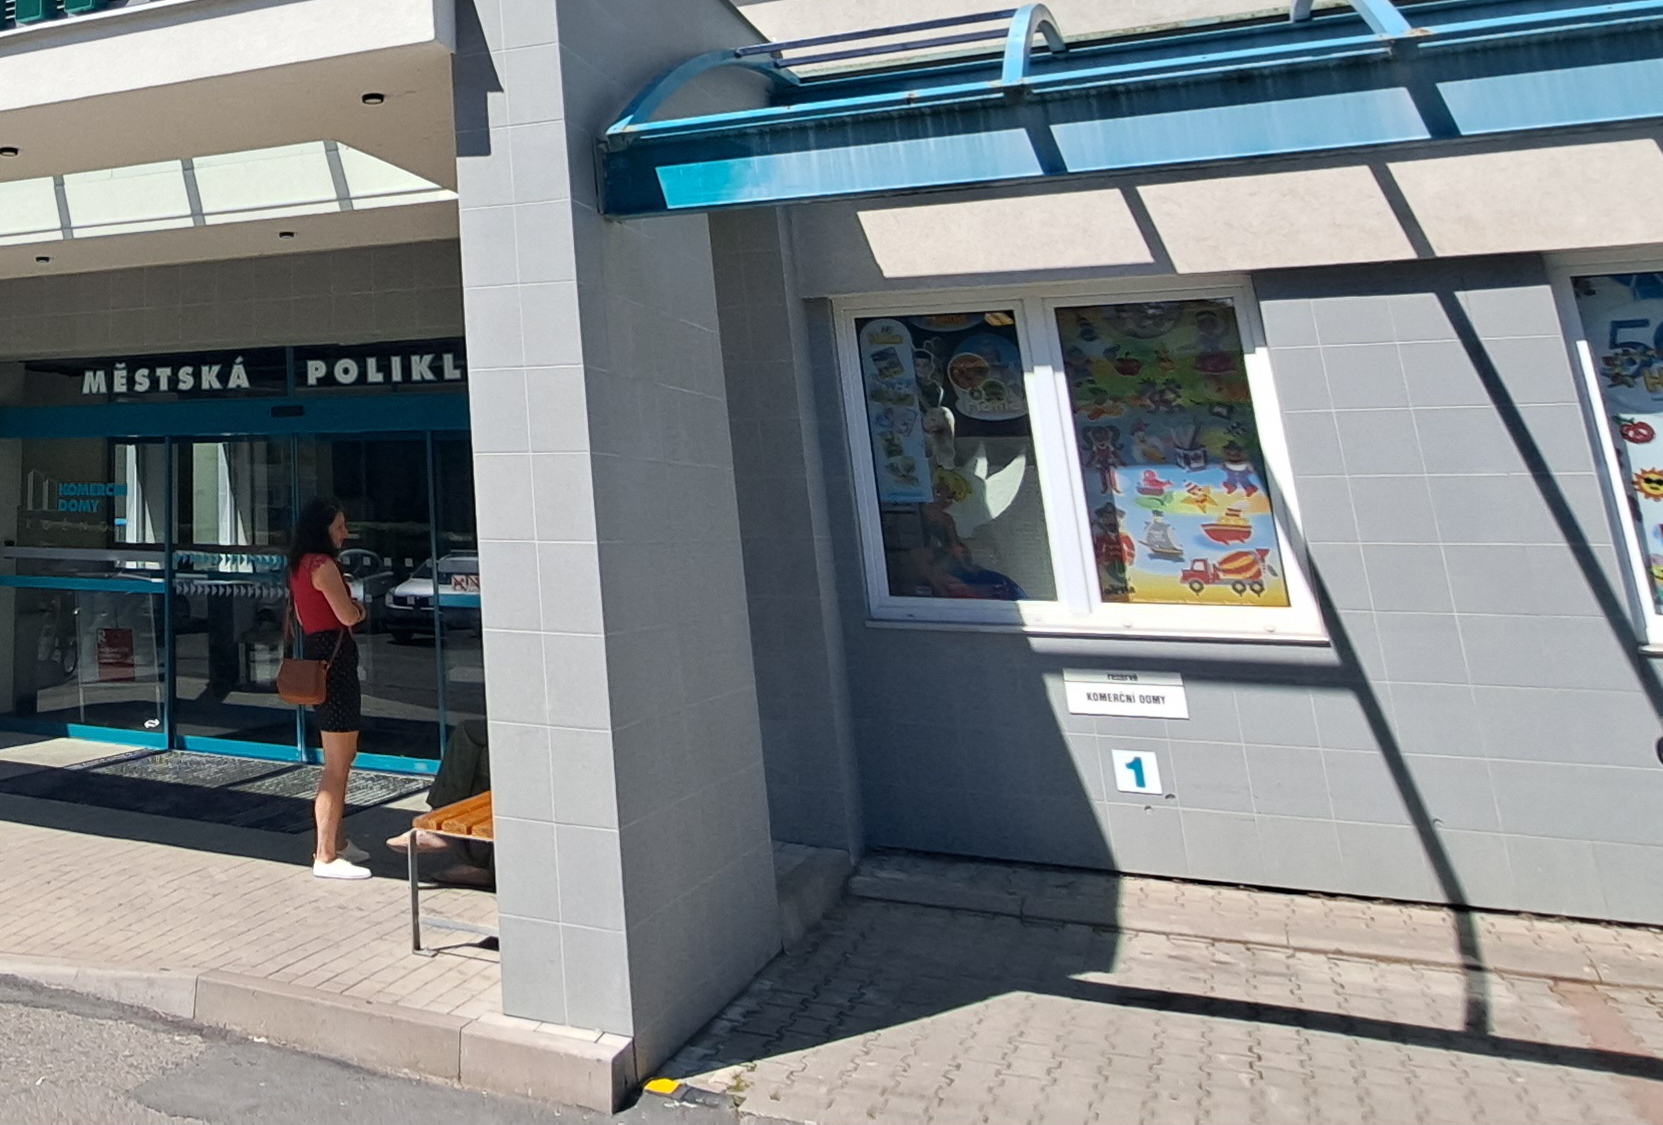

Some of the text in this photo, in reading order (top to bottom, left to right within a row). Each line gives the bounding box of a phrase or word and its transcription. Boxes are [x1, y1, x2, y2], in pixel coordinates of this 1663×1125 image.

[82, 353, 462, 395] MĚSTSKÁ POLIKL
[58, 499, 99, 513] DOMY
[1086, 691, 1166, 705] KOMERČNÍ DOMY
[1125, 756, 1146, 789] 1
